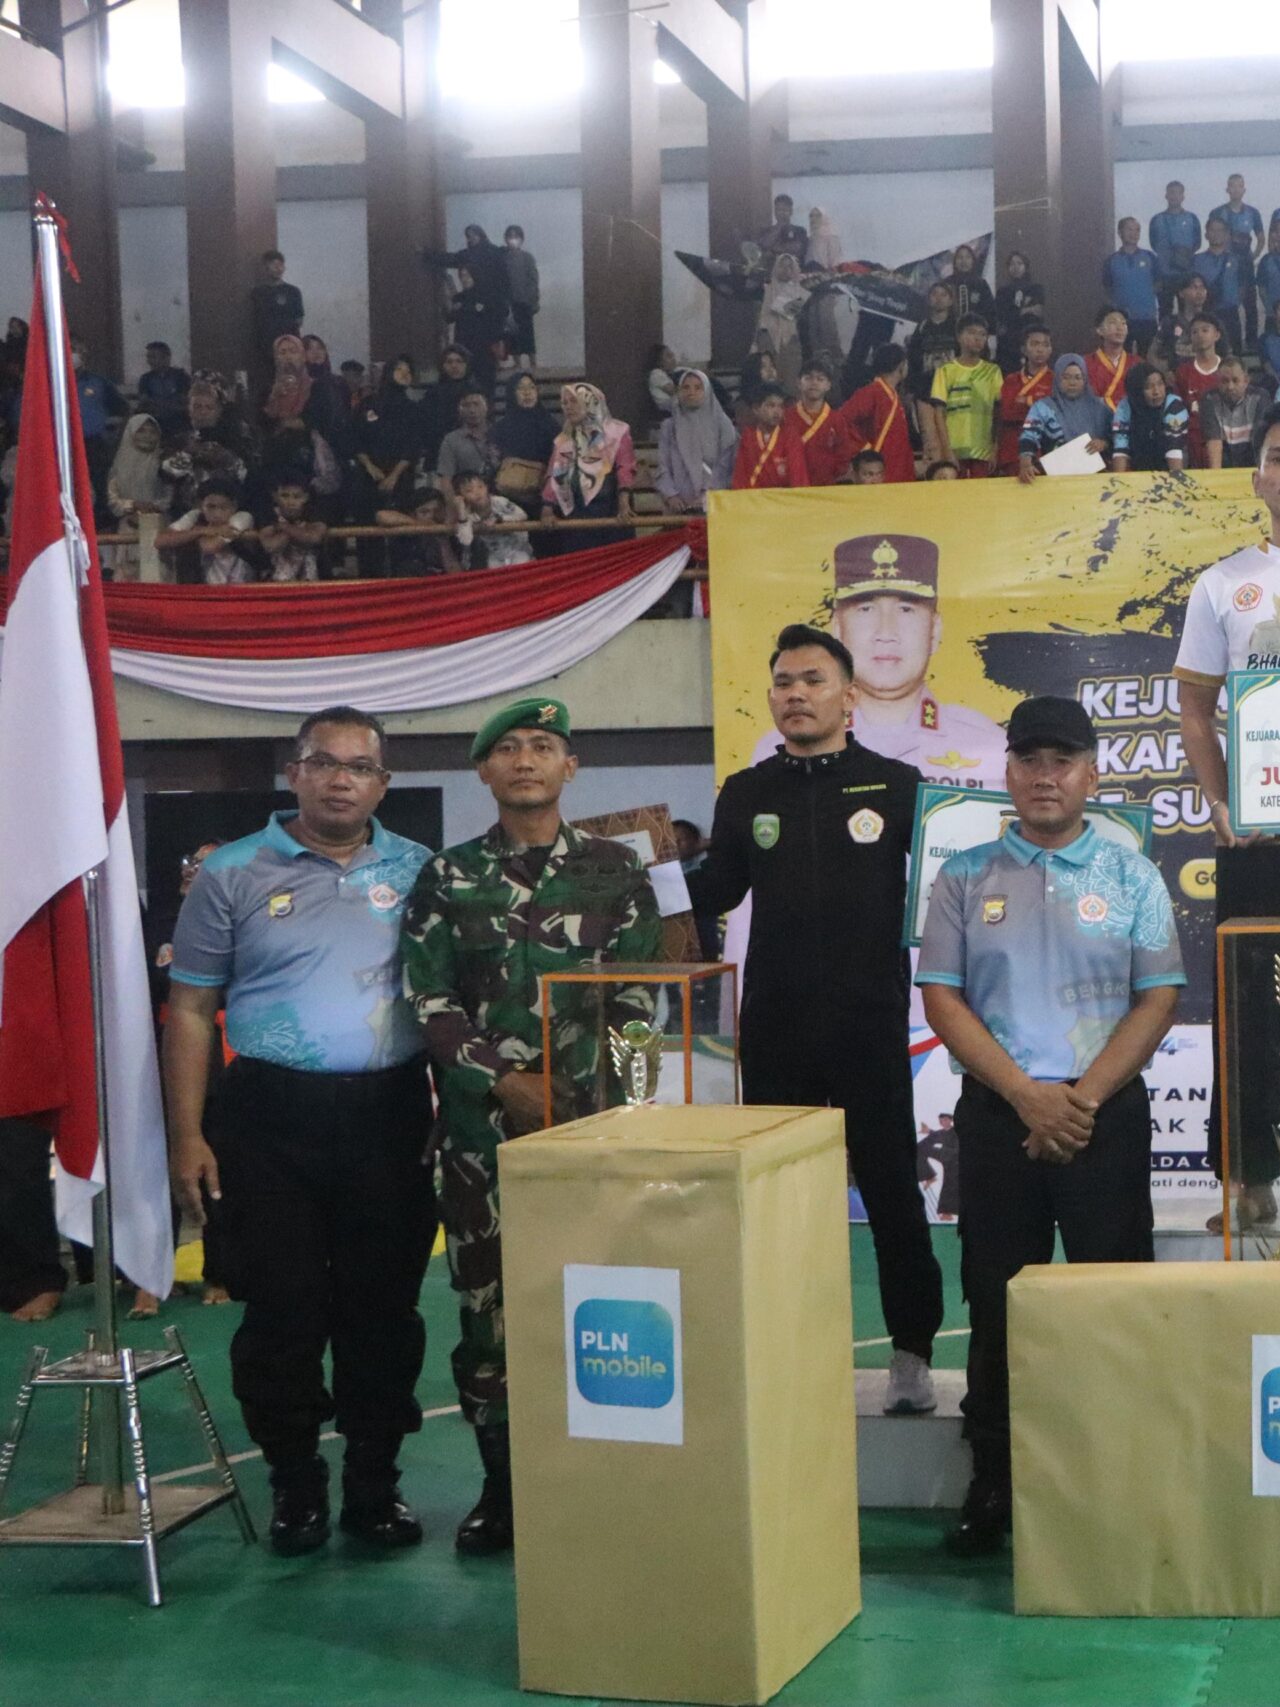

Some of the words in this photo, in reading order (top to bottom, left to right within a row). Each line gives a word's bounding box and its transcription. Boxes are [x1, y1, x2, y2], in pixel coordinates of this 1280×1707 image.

[1152, 789, 1212, 827] SU
[581, 1330, 629, 1352] PLN
[582, 1354, 668, 1378] mobile
